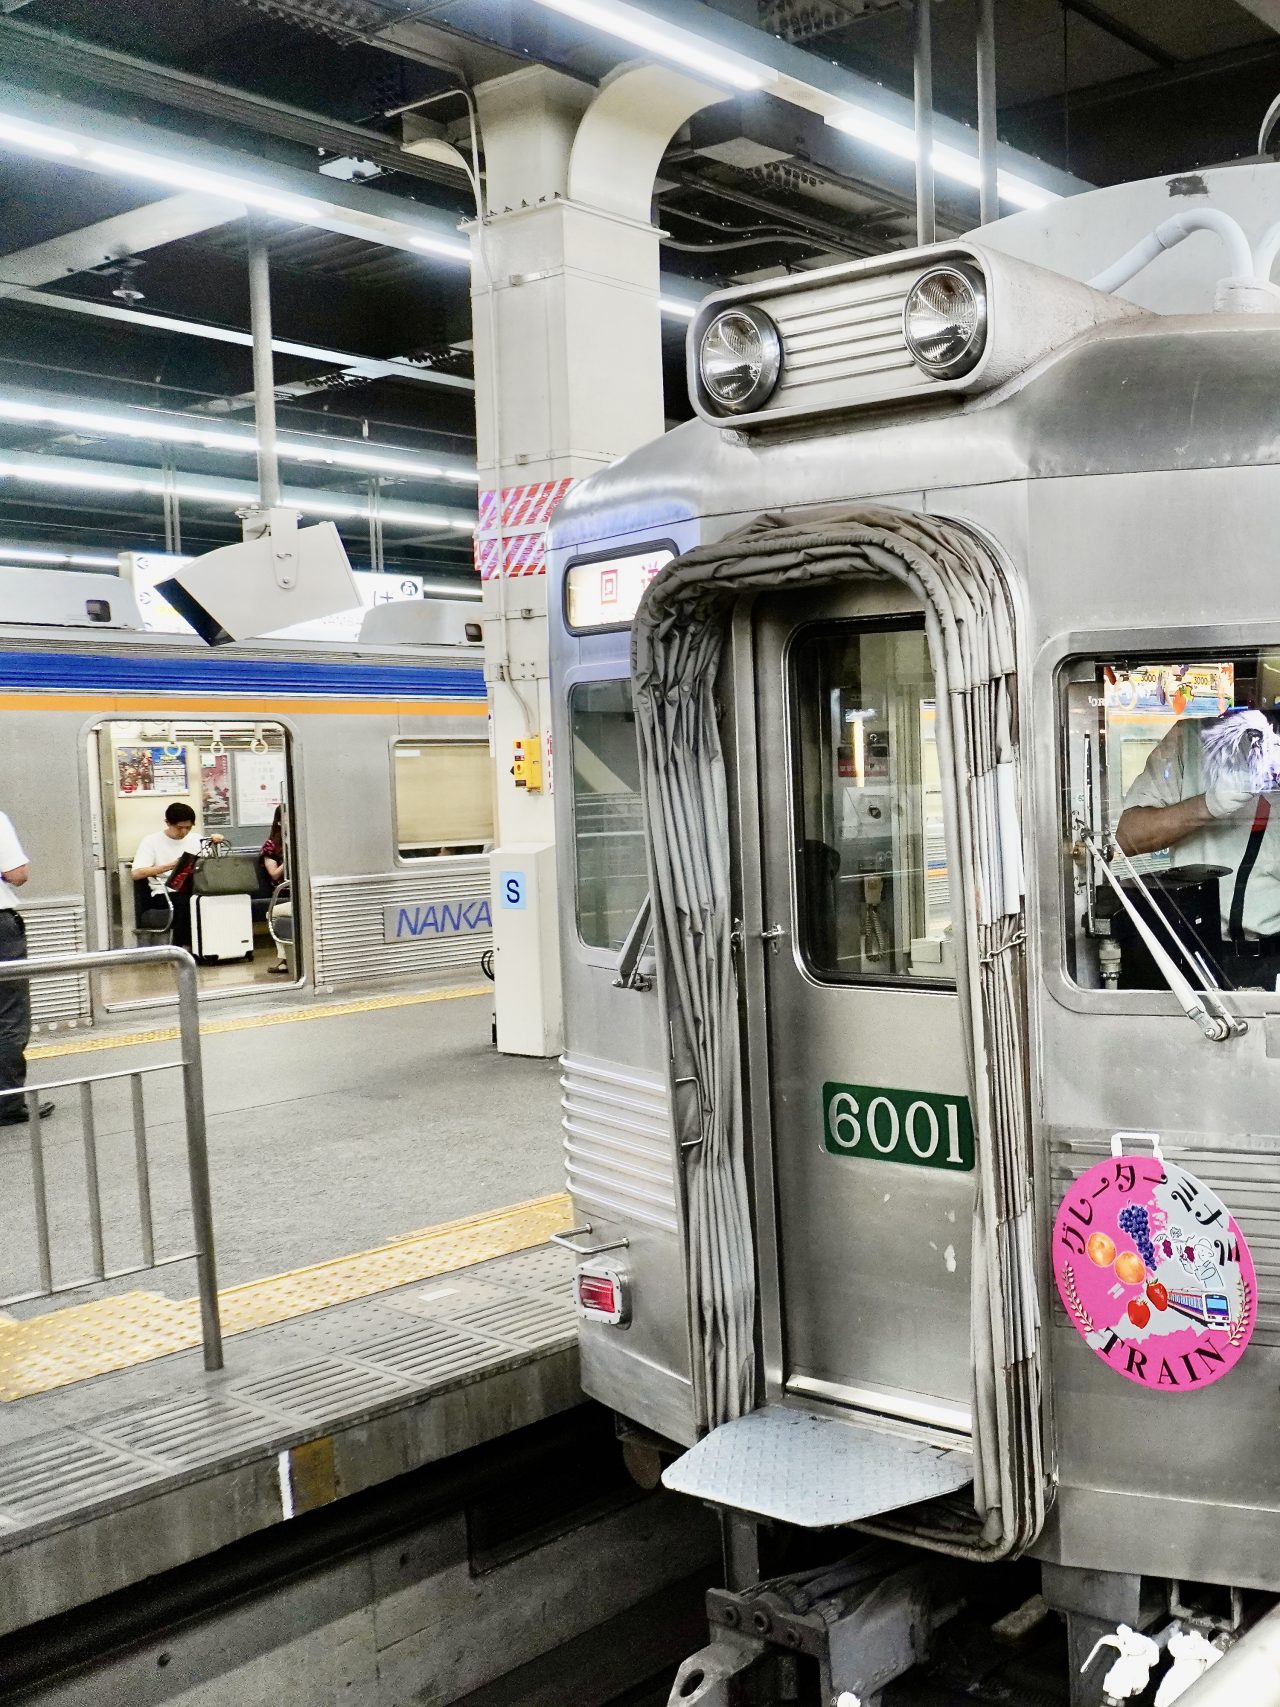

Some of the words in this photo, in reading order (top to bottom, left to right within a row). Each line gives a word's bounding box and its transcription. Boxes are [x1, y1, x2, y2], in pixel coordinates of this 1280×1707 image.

[506, 879, 520, 904] S
[828, 1092, 964, 1164] 6001
[1100, 1326, 1226, 1386] TRAIN
